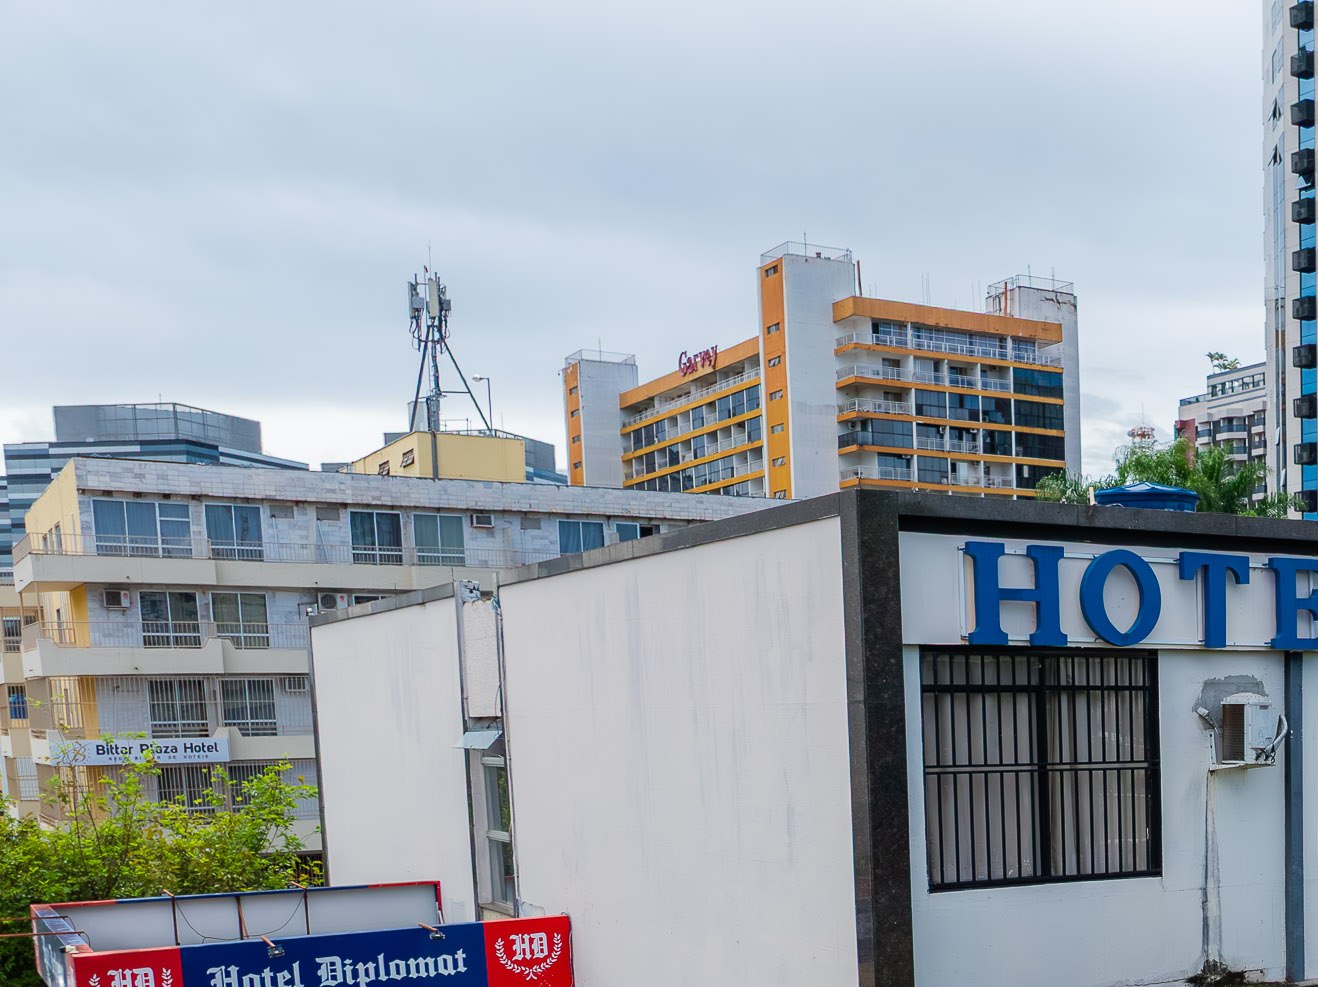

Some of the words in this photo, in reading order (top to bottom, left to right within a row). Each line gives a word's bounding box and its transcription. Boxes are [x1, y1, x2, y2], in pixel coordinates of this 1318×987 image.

[679, 345, 718, 377] Garvey
[183, 742, 219, 754] Hotel
[509, 932, 549, 961] HD
